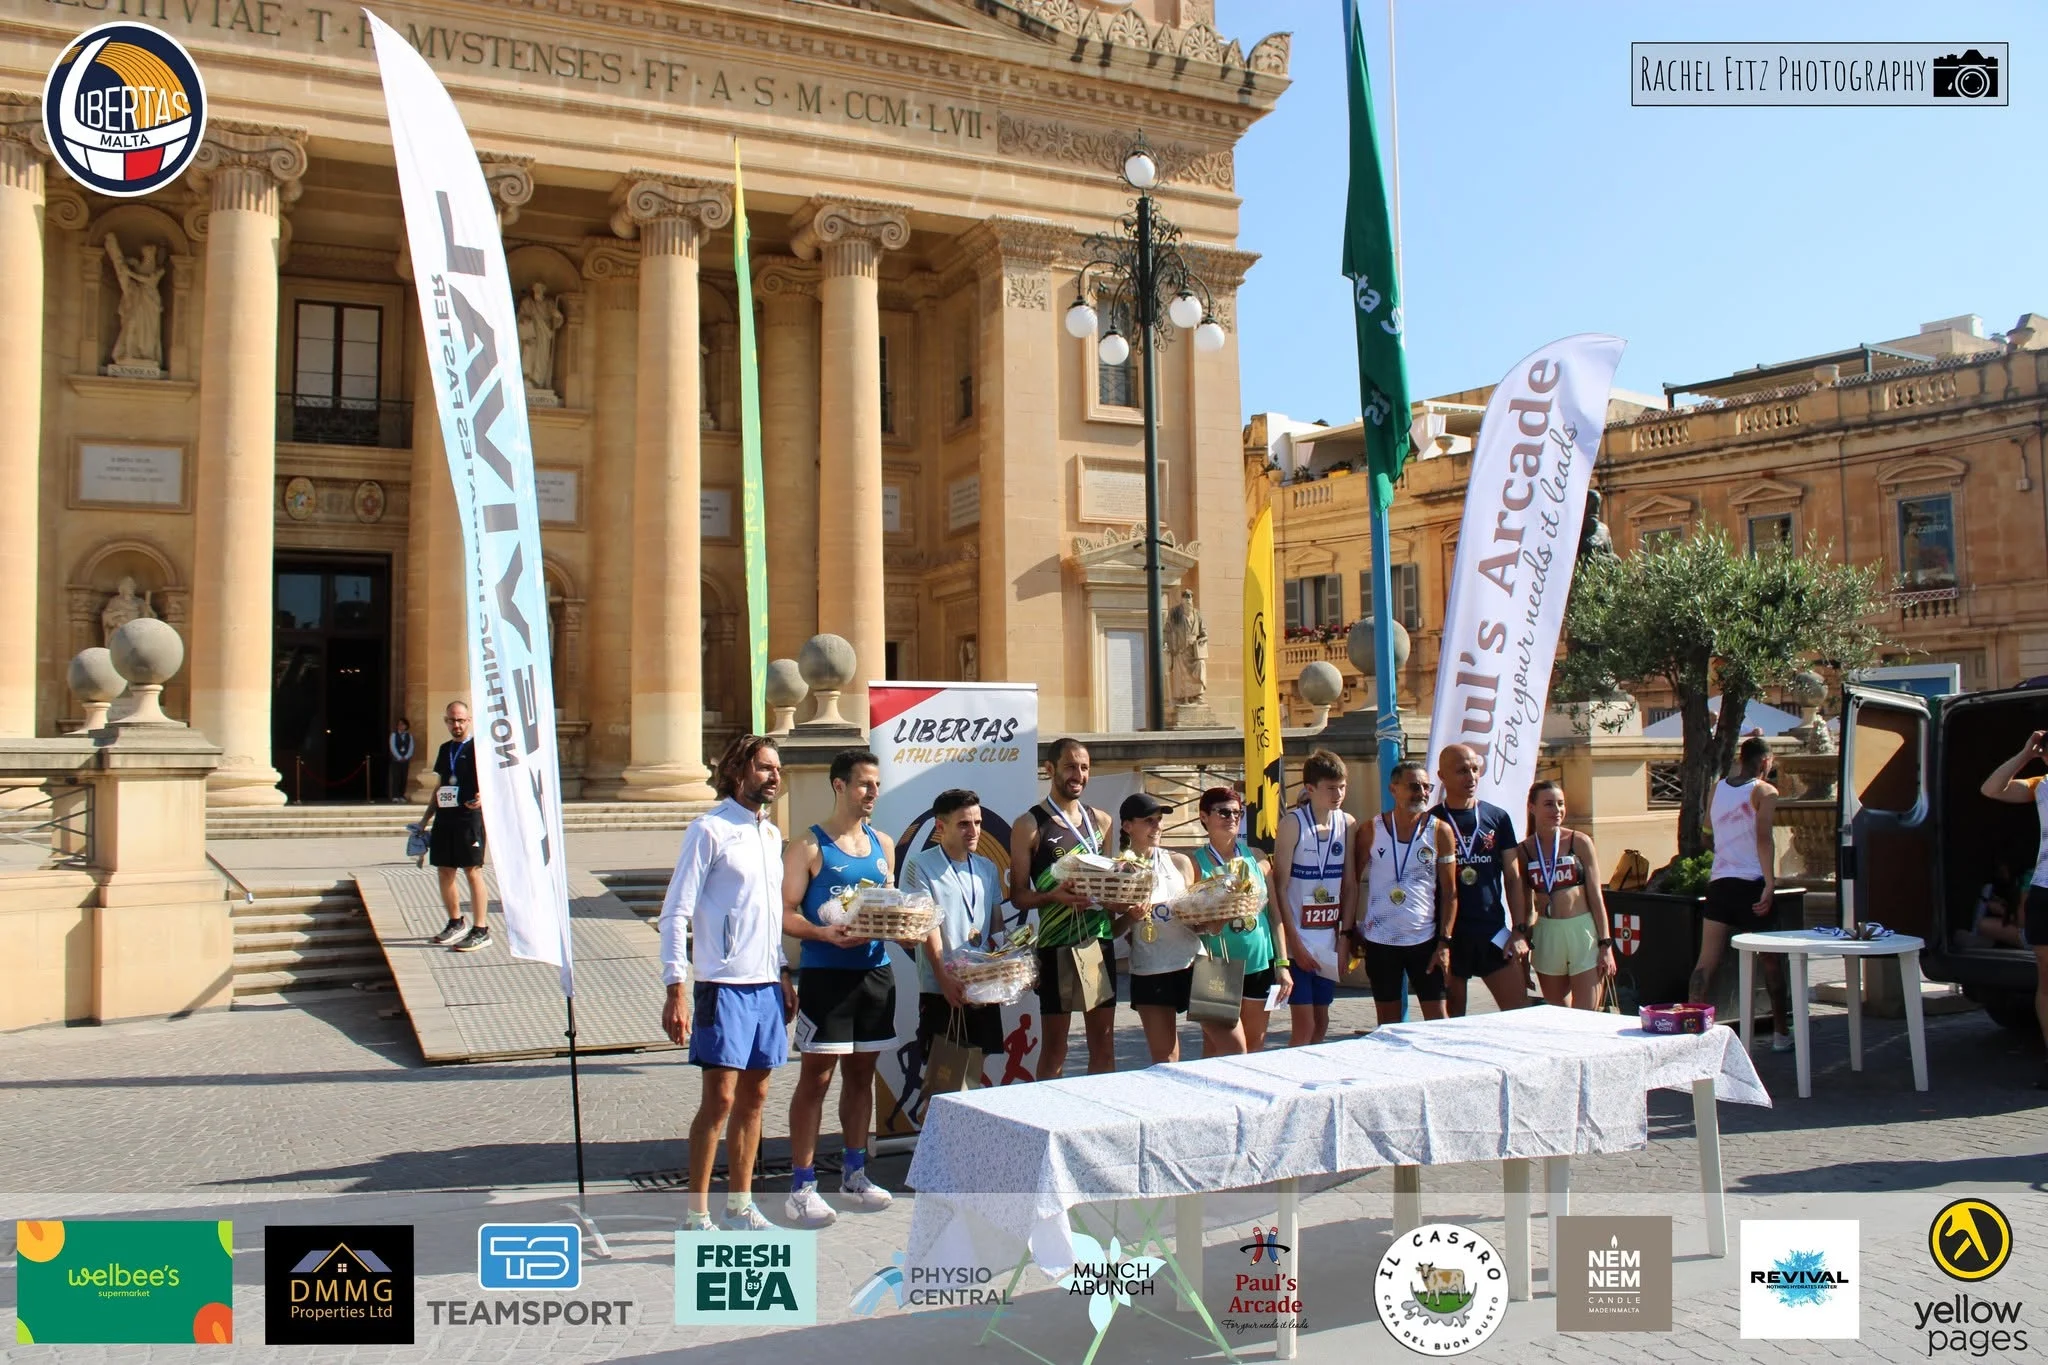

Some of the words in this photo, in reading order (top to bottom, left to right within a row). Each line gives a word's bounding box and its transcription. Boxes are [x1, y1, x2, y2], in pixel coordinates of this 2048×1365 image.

[308, 8, 332, 42] T
[711, 70, 732, 101] A
[754, 77, 775, 106] S
[798, 83, 822, 114] M
[845, 91, 907, 127] CCM
[1477, 359, 1561, 598] Arcade
[1540, 421, 1578, 504] leads
[1541, 510, 1560, 539] it
[1522, 543, 1553, 627] needs
[1512, 630, 1540, 724] your
[893, 717, 1019, 744] LIBERTAS
[893, 746, 976, 765] ATHLETICS
[979, 746, 1020, 763] CLUB
[1306, 909, 1339, 923] 12120
